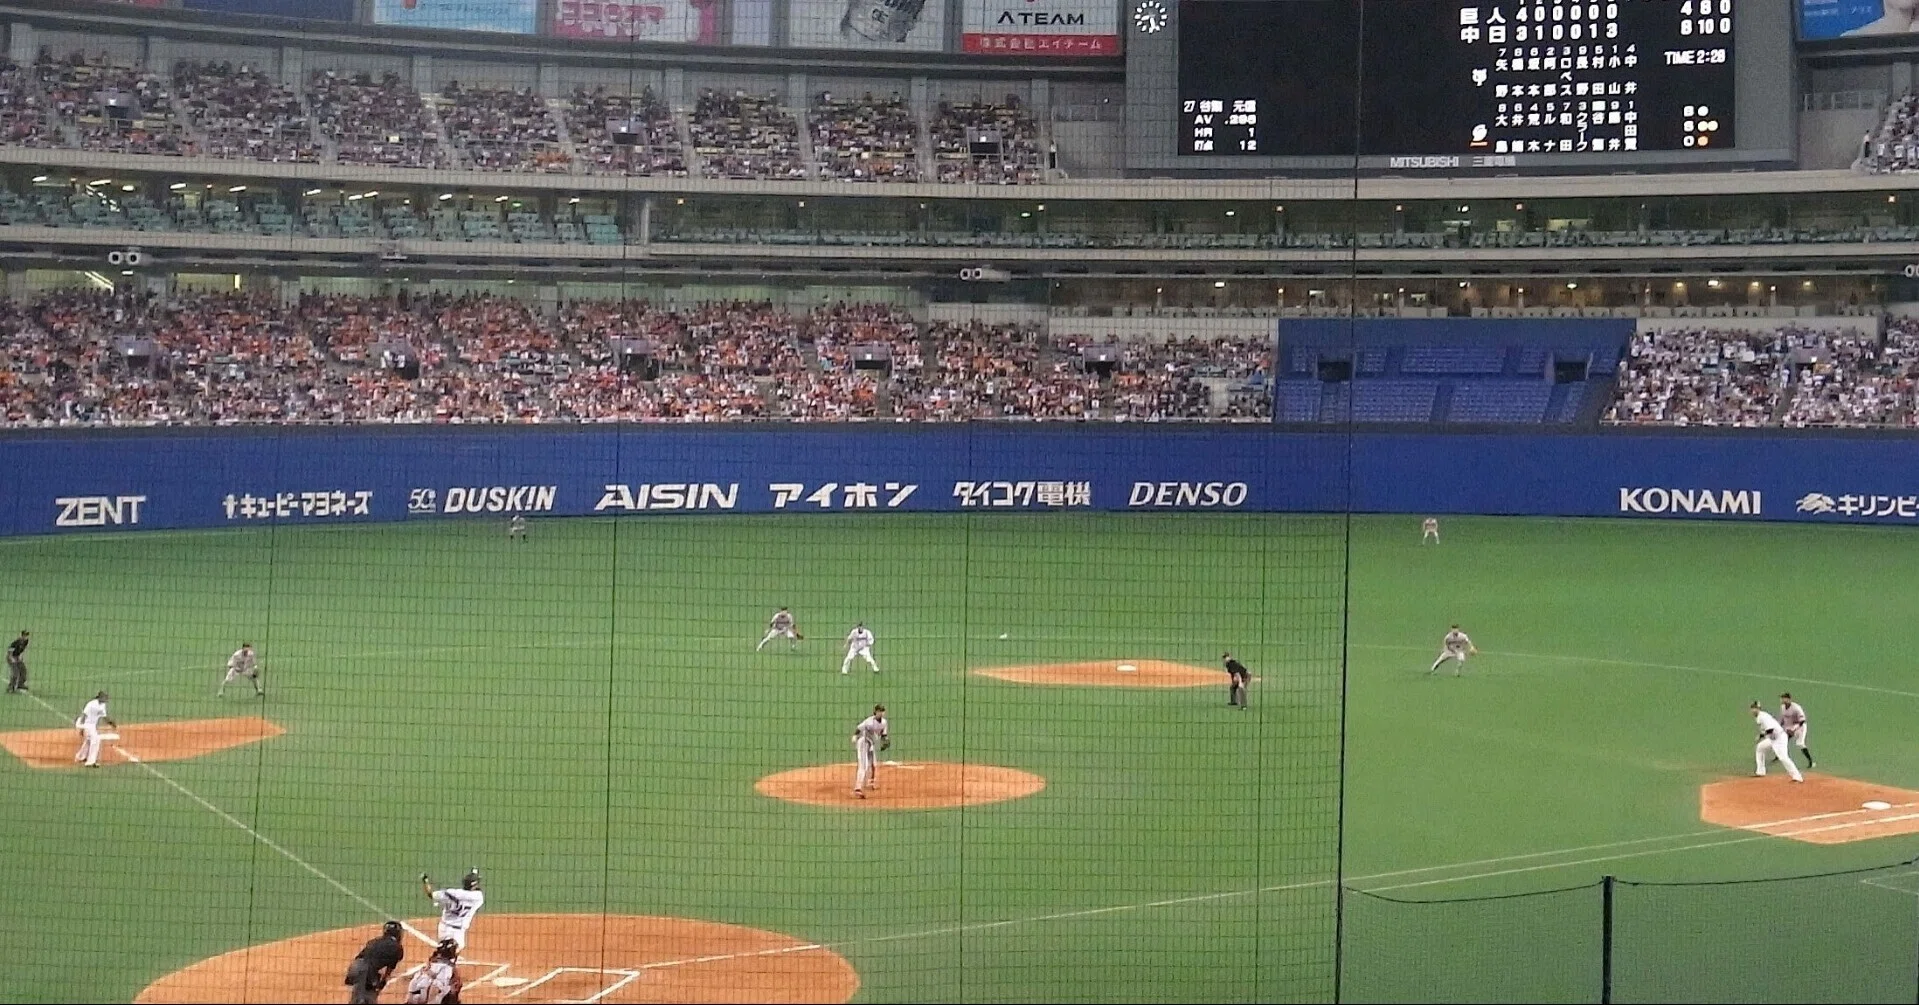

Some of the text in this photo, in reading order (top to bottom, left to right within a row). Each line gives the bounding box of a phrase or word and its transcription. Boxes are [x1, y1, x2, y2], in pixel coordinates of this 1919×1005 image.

[1516, 7, 1527, 21] 4
[1535, 6, 1545, 21] 0
[1553, 6, 1563, 20] 0
[1571, 5, 1581, 20] 0
[1589, 5, 1599, 19] 0
[1607, 4, 1617, 19] 0
[1681, 1, 1692, 15] 4
[1720, 0, 1730, 14] 0
[1461, 26, 1505, 43] 中日
[1516, 26, 1527, 41] 3
[1535, 25, 1543, 40] 1
[1553, 25, 1563, 40] 0
[1571, 24, 1581, 39] 0
[1589, 24, 1597, 38] 1
[1606, 23, 1617, 38] 3
[1698, 19, 1714, 34] 10
[1720, 18, 1730, 33] 0
[1195, 115, 1213, 124] AV
[1240, 140, 1256, 150] 12
[1249, 128, 1254, 137] 1
[1390, 156, 1459, 168] MITSUBISHI
[594, 483, 739, 510] AISIN
[769, 482, 918, 508] アイホン
[953, 481, 1091, 506] ダイコク電機
[1128, 481, 1248, 506] DENSO
[1619, 487, 1761, 515] KONAMI
[1837, 494, 1919, 517] キリンビ
[55, 495, 146, 526] ZENT
